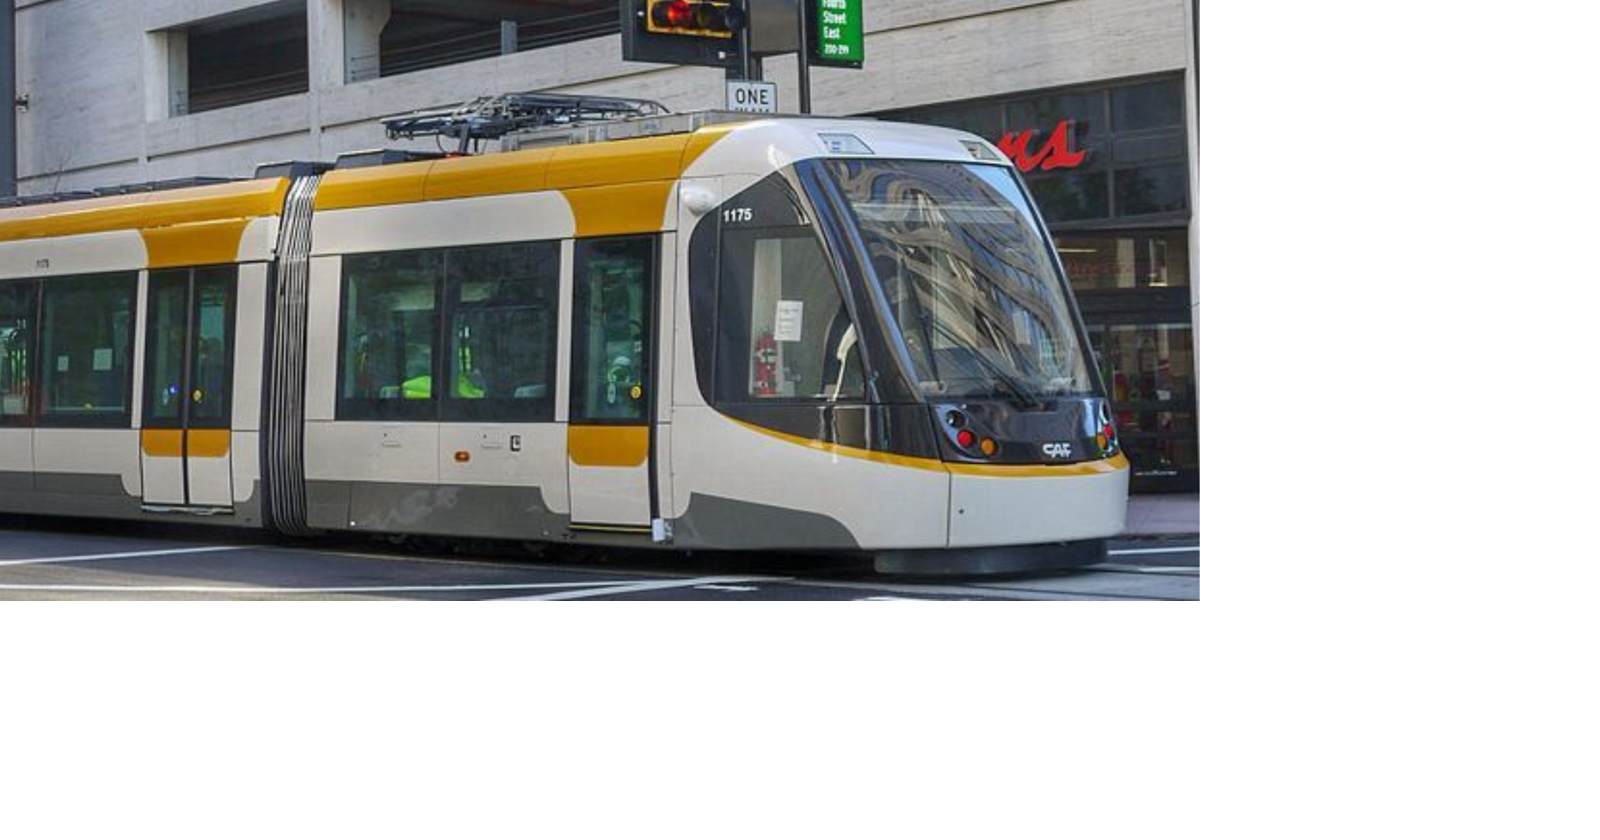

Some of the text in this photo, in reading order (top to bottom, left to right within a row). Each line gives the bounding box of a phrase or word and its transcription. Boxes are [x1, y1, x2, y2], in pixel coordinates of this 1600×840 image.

[822, 10, 847, 25] Street
[823, 26, 840, 39] East
[735, 87, 769, 105] ONE
[722, 207, 753, 222] 1175
[1042, 442, 1072, 458] CAF
